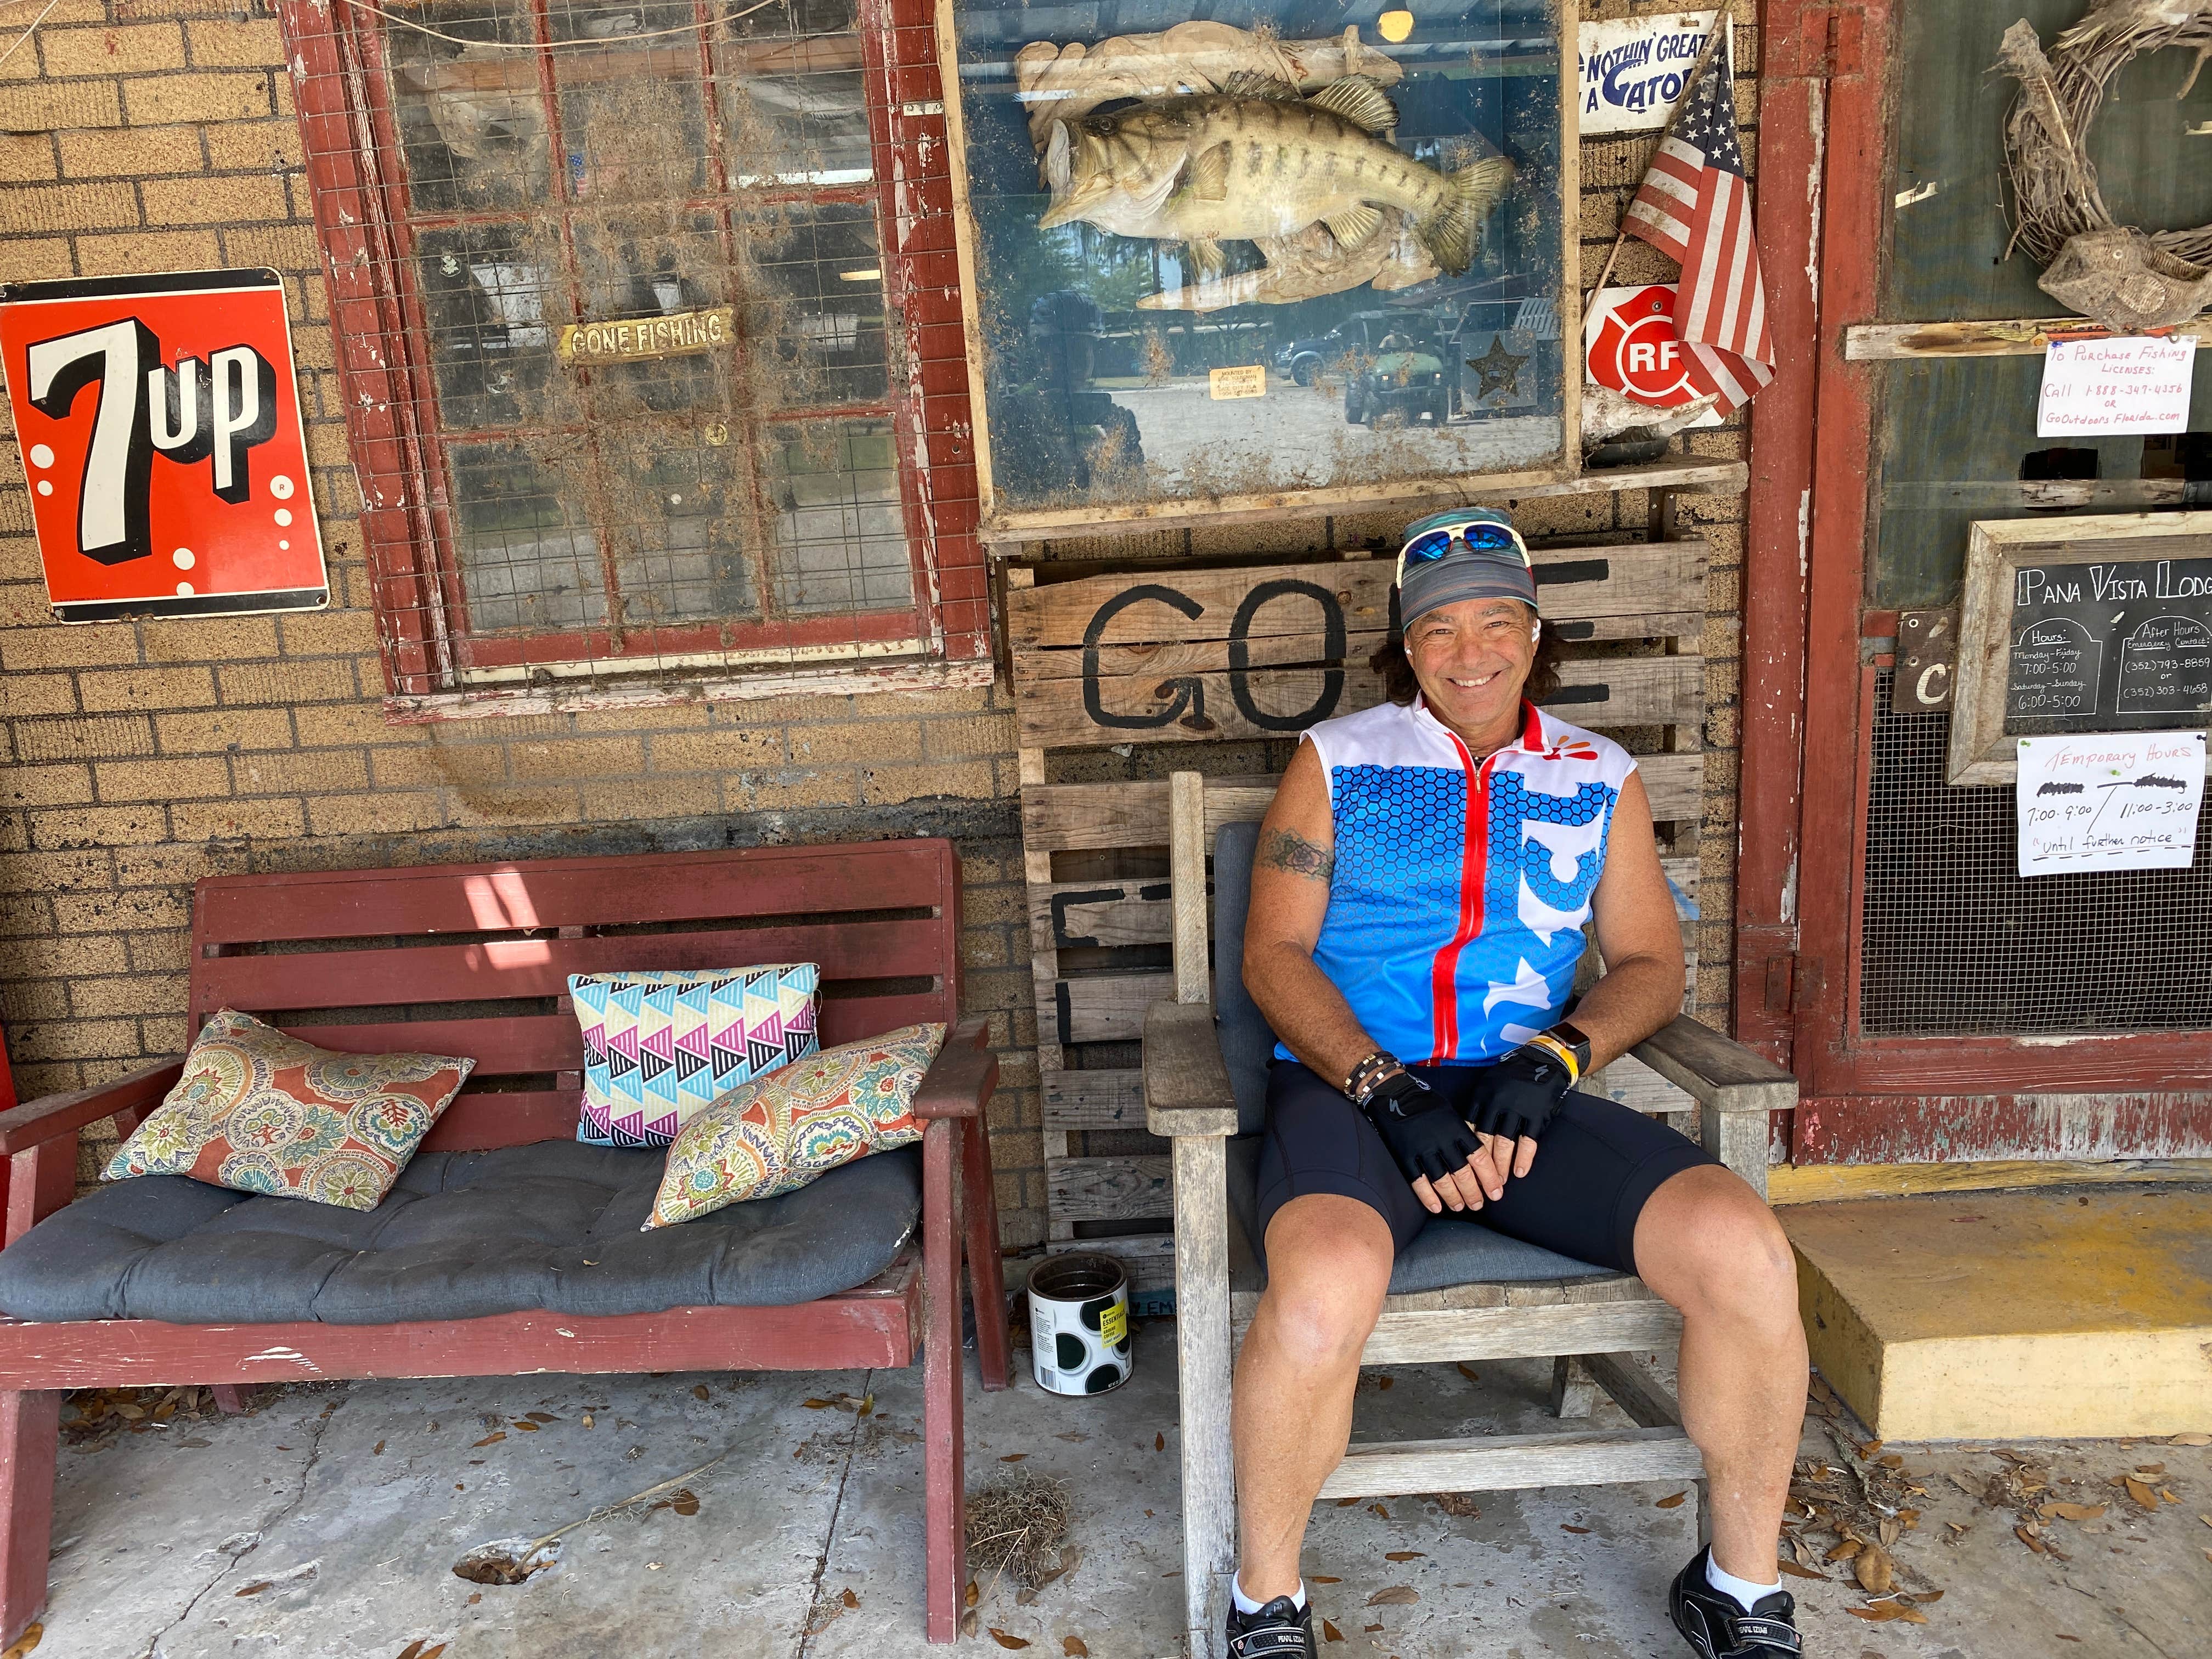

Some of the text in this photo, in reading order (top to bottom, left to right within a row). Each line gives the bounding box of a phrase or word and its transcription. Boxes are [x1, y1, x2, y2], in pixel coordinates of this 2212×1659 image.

[1586, 87, 1599, 114] A
[571, 314, 722, 354] GONE FISHING
[2051, 345, 2065, 362] To
[2017, 561, 2212, 606] PANA VISTA LODG
[2032, 629, 2067, 644] Hours:
[2142, 621, 2200, 639] After Hours
[1082, 558, 1610, 731] GOE
[2127, 637, 2210, 651] Emergency Contact:
[1103, 1308, 1125, 1327] ESSENTIALS
